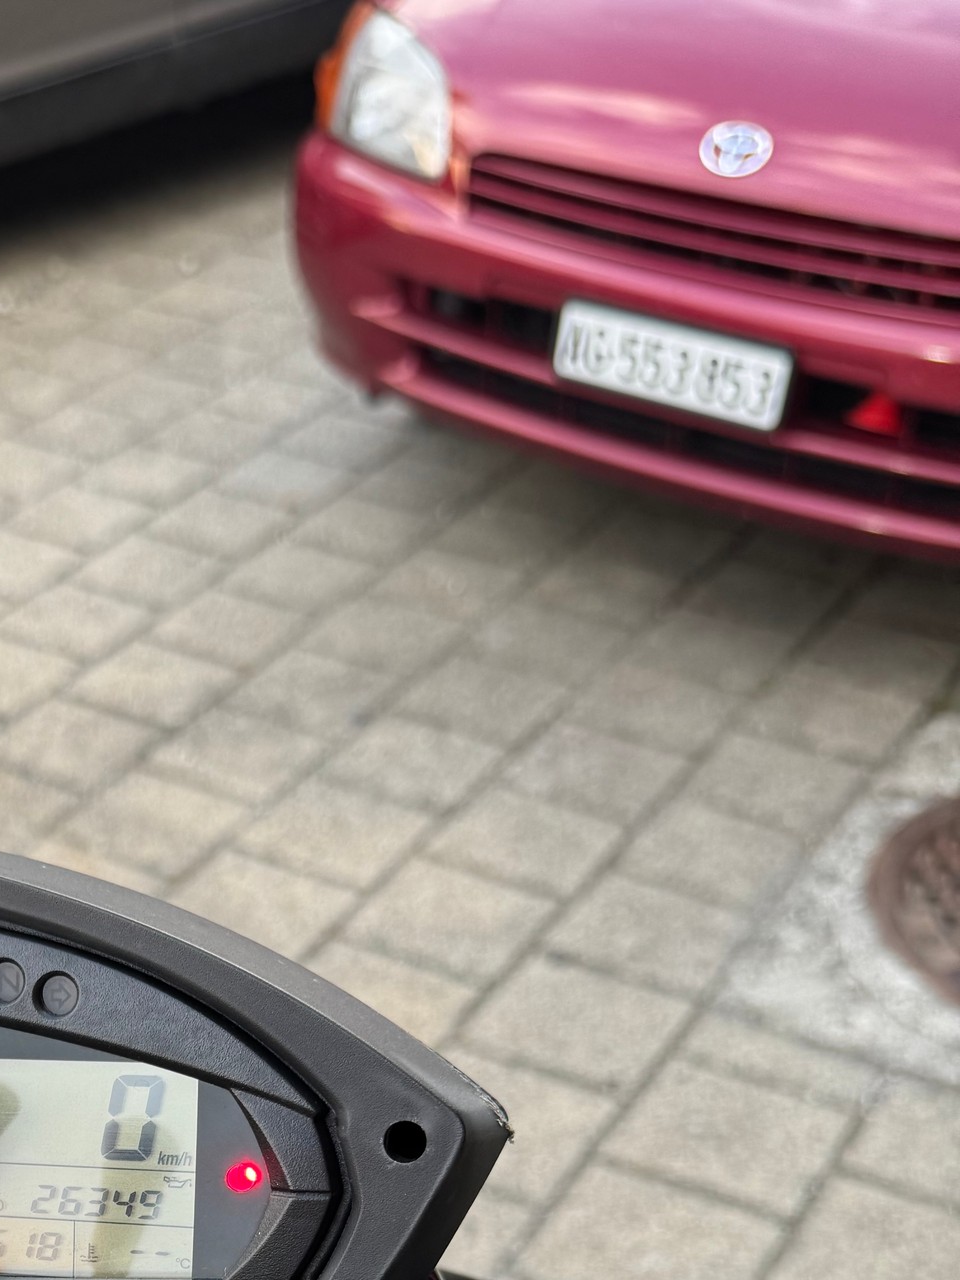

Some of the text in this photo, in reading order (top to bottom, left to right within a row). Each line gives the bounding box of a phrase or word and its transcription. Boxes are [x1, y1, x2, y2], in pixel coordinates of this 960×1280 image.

[100, 1074, 165, 1161] 0
[157, 1151, 193, 1168] km/h
[30, 1184, 163, 1220] 26349
